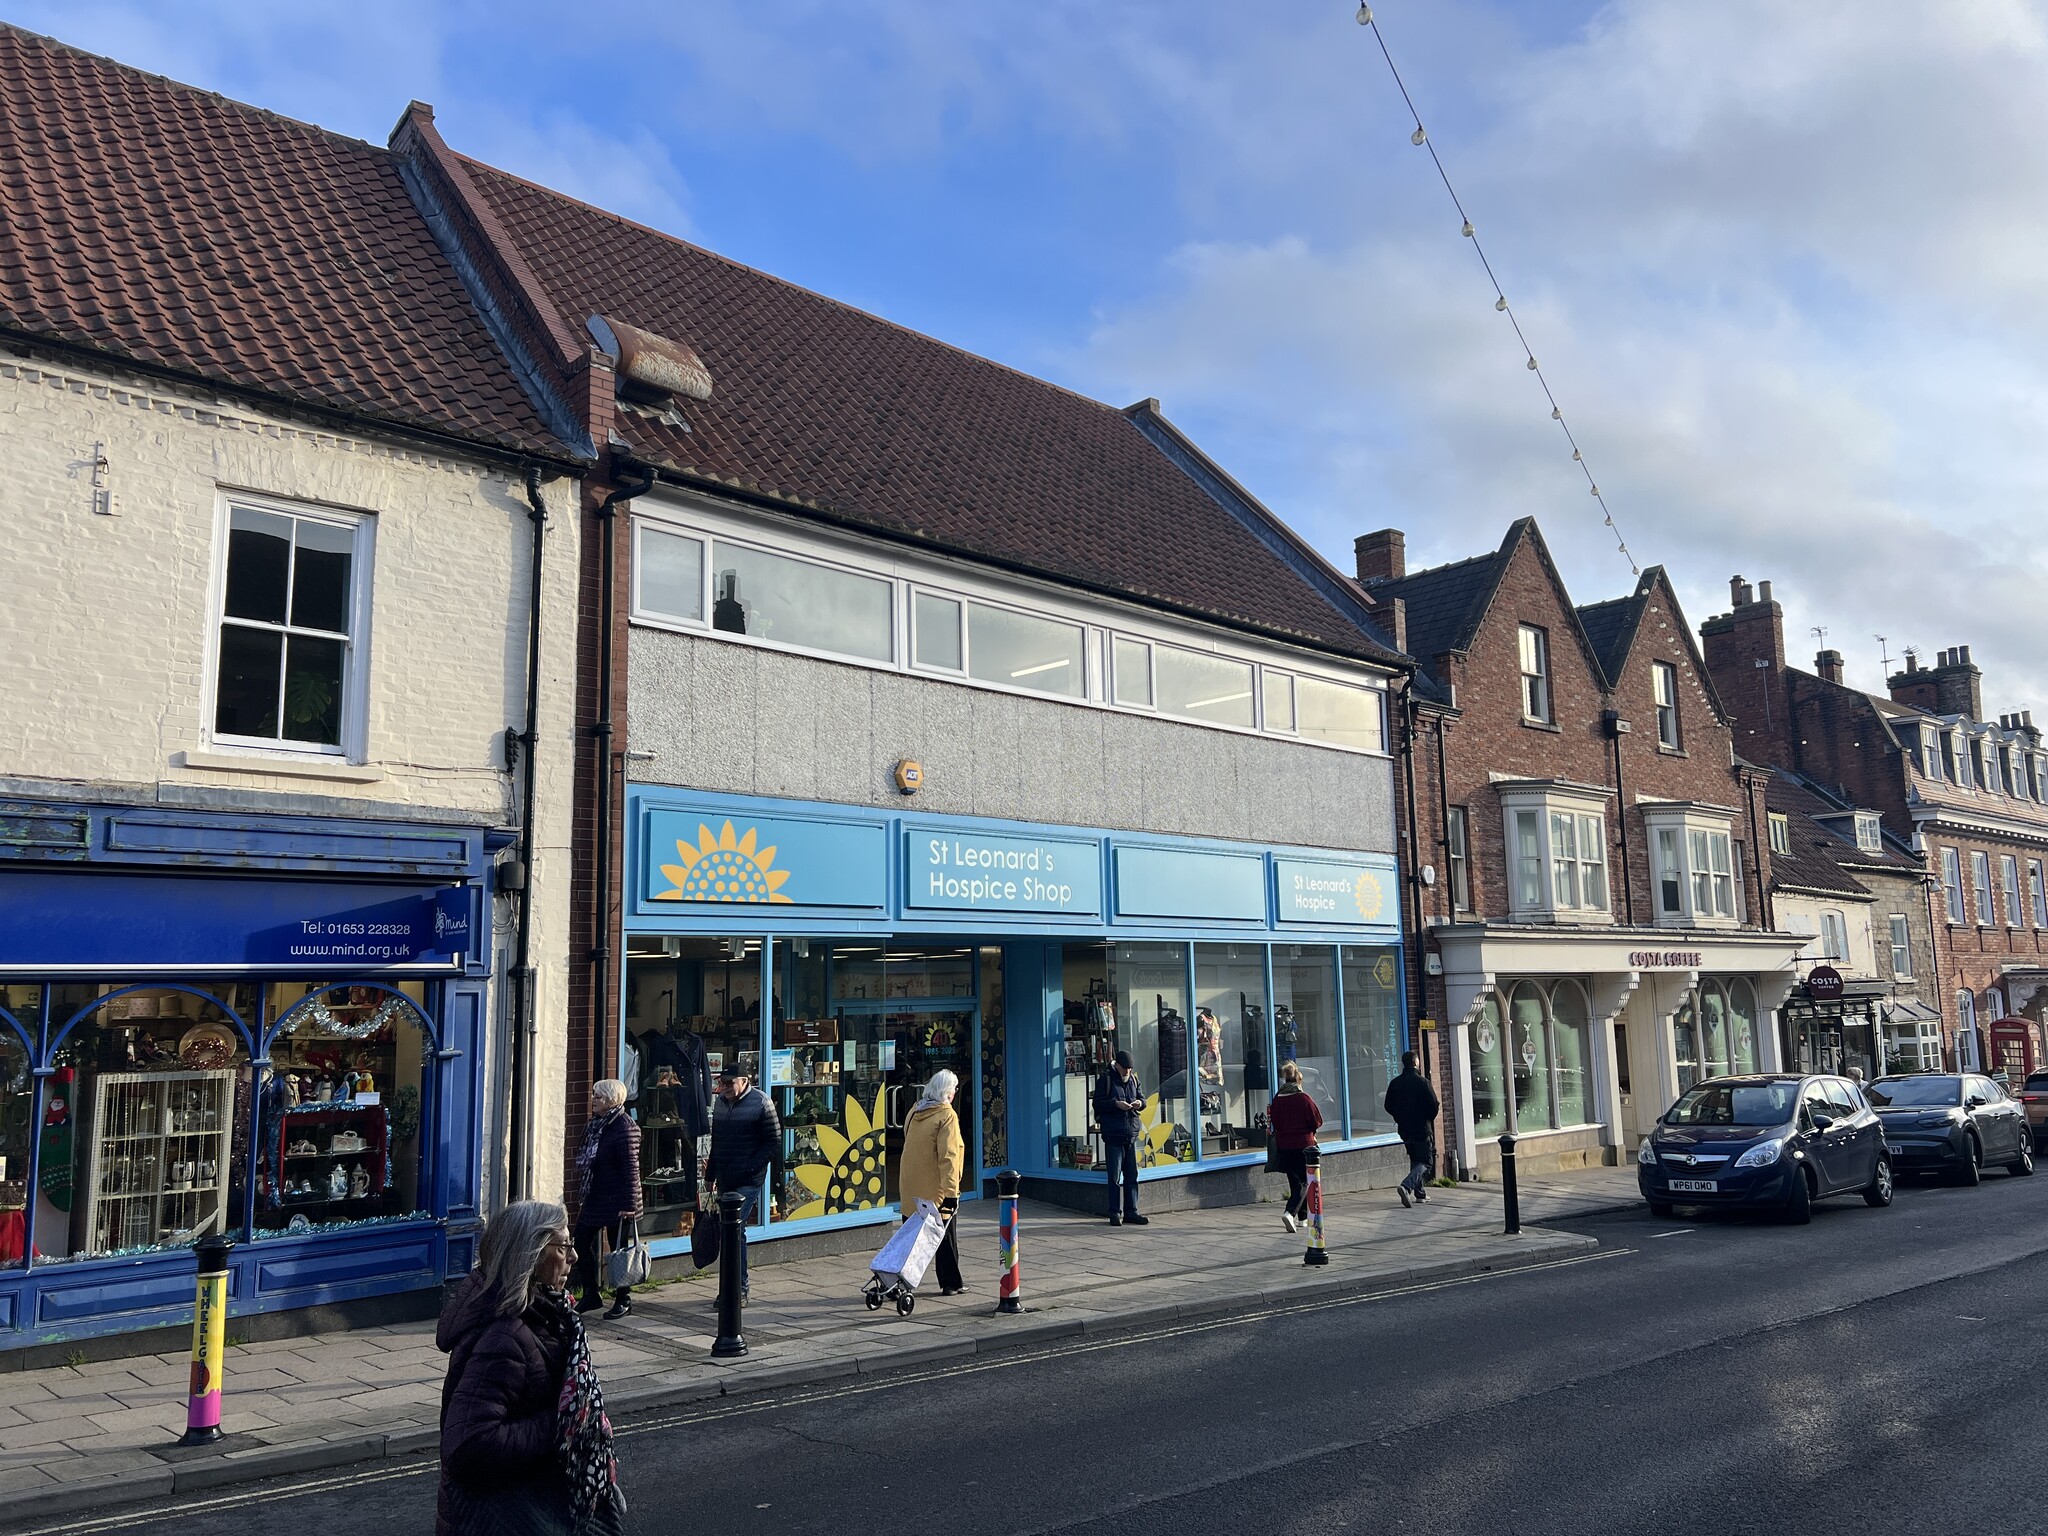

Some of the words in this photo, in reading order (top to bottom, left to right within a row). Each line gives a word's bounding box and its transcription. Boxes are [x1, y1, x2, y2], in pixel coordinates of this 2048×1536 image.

[929, 839, 949, 865] St
[955, 841, 1054, 872] Leonard's
[930, 871, 1017, 904] Hospice
[1023, 876, 1073, 908] Shop
[1294, 874, 1303, 890] St
[1306, 876, 1351, 893] Leonard's
[1295, 893, 1335, 912] Hospice
[300, 920, 325, 934] Tel:
[327, 923, 365, 935] 01653
[367, 923, 411, 935] 228328
[290, 943, 410, 958] www.mind.org.uk
[1628, 951, 1662, 969] COSTA
[1663, 951, 1703, 966] COFFEE
[1811, 977, 1840, 986] COSTA
[197, 1285, 212, 1395] WHEELGATE
